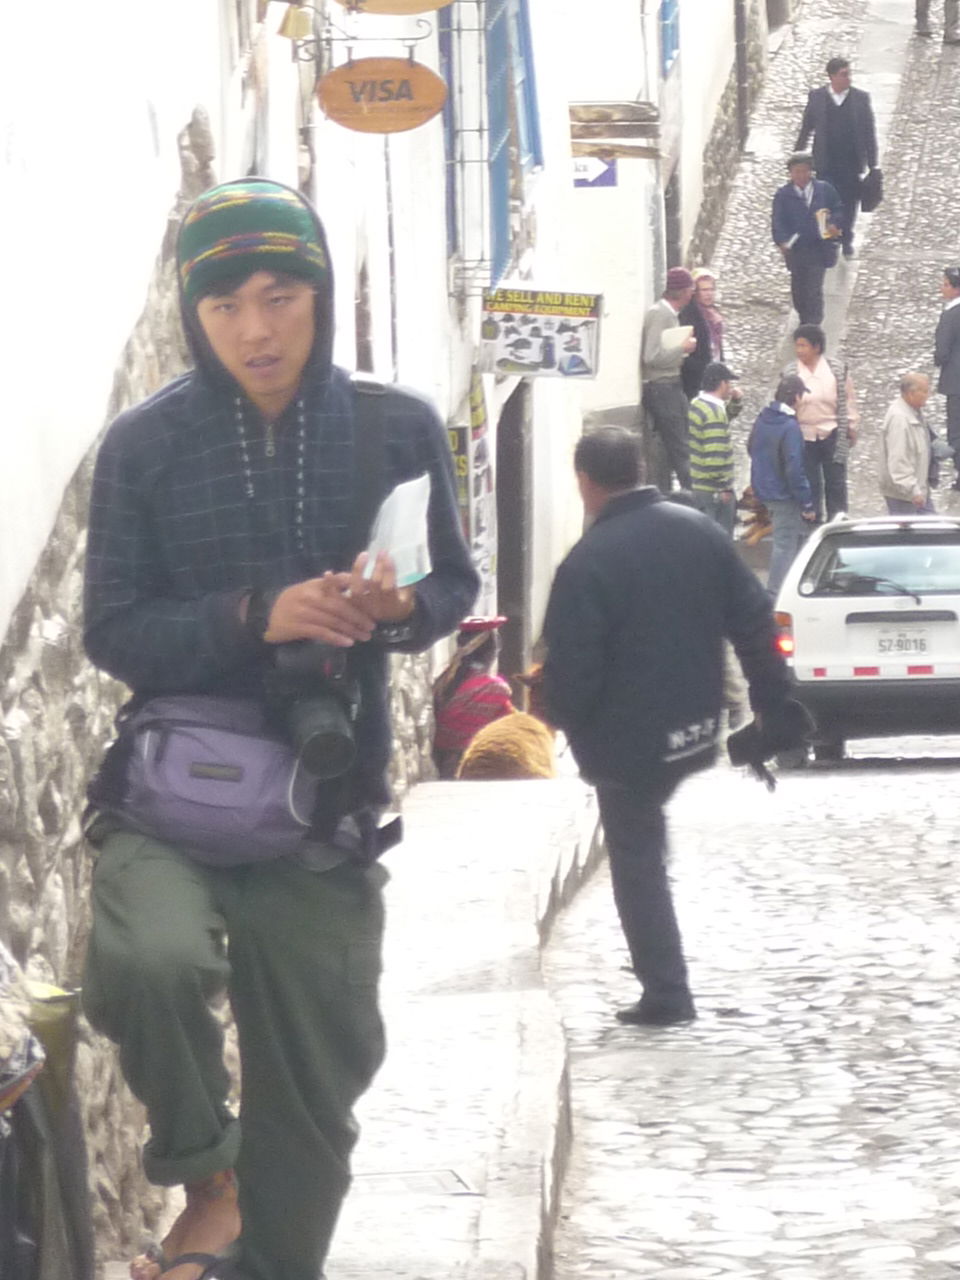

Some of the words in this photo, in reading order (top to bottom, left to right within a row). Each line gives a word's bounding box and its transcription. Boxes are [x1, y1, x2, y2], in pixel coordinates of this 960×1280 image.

[344, 79, 415, 103] VISA
[507, 290, 532, 302] SELL
[536, 292, 562, 305] AND
[565, 295, 597, 308] RENT
[534, 305, 592, 316] EQUIPMENT
